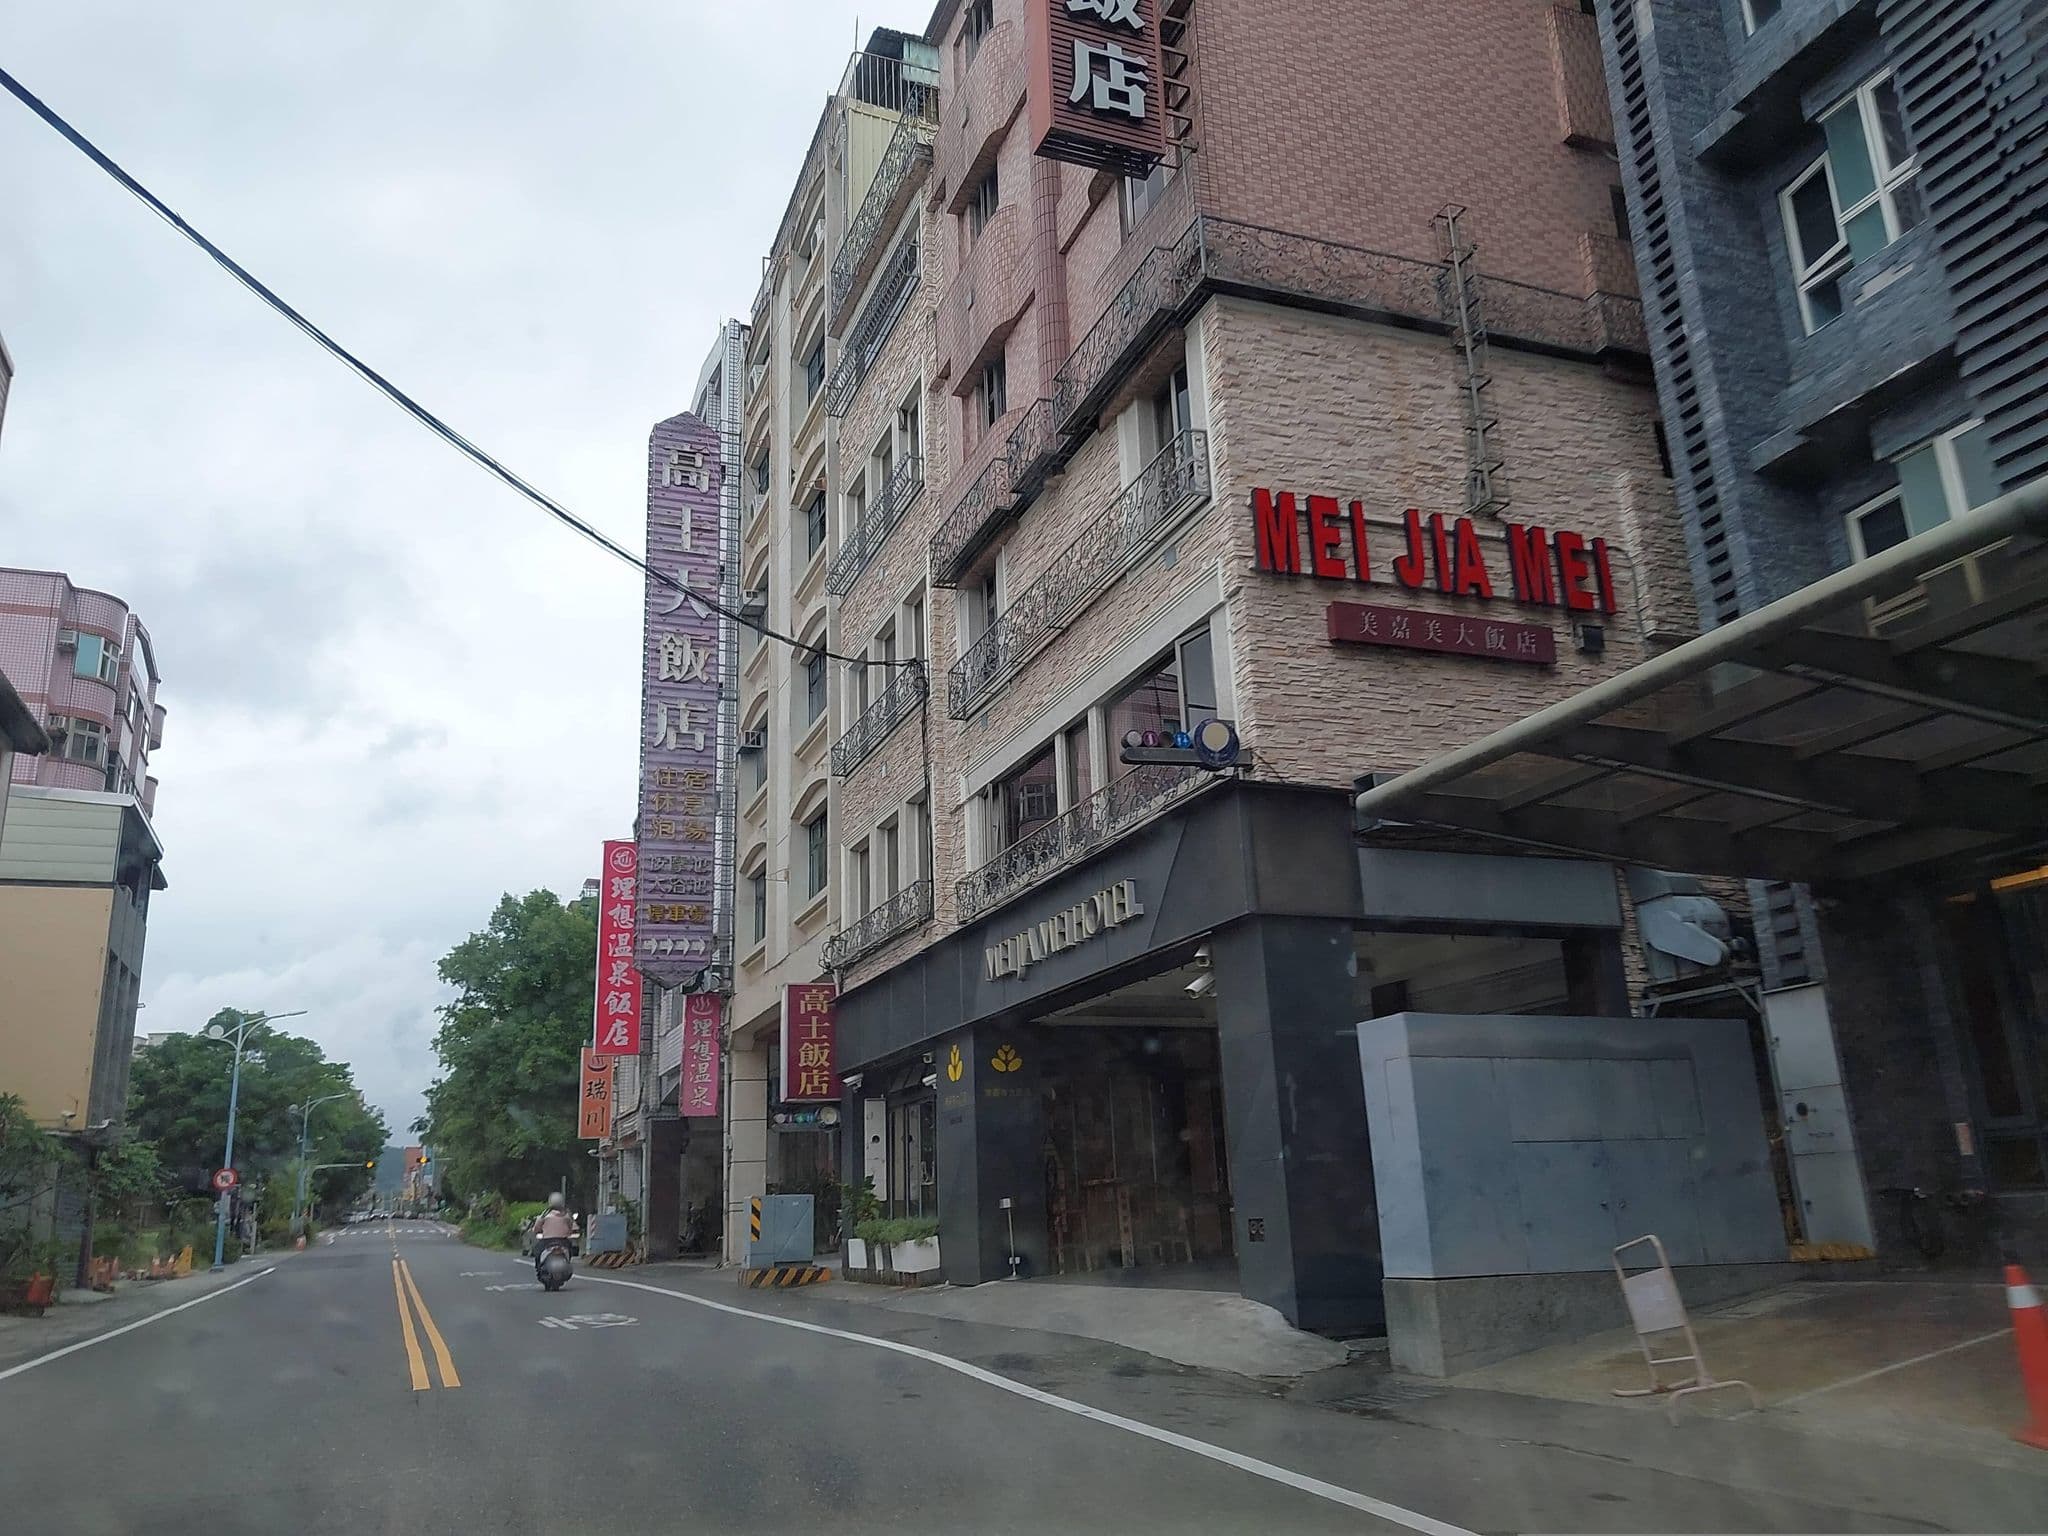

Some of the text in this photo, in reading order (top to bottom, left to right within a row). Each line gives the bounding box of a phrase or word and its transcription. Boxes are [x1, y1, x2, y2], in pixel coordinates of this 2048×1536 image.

[1251, 487, 1617, 616] MEI JIA MEI
[654, 443, 712, 752] 高士大飯店
[1358, 610, 1537, 656] 美嘉美大飯店
[653, 767, 708, 790] 住宿
[799, 989, 831, 1096] 高士飯店
[586, 1079, 609, 1132] 瑞川
